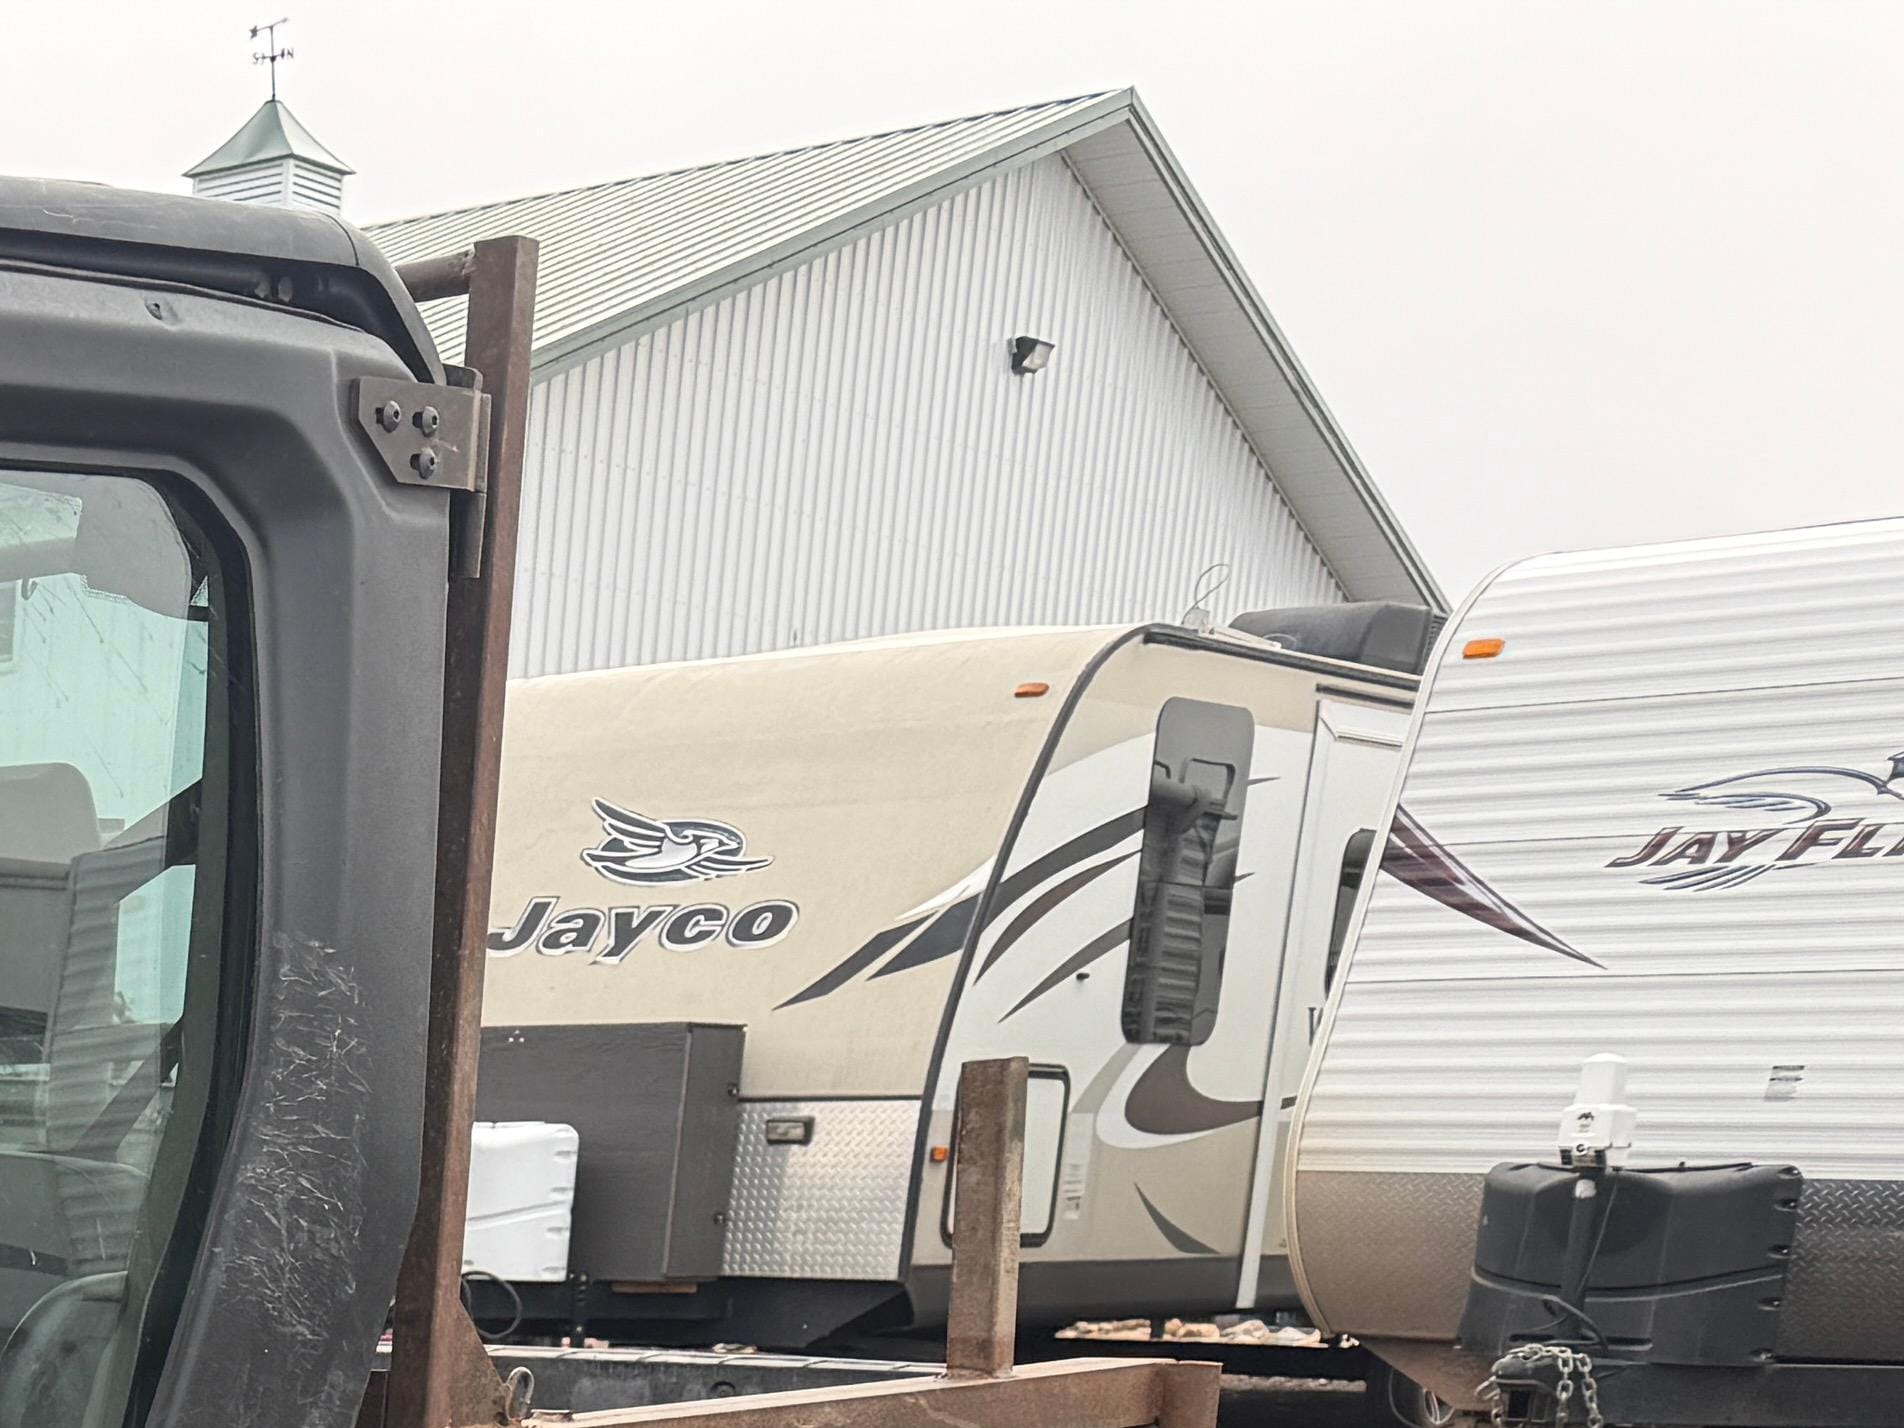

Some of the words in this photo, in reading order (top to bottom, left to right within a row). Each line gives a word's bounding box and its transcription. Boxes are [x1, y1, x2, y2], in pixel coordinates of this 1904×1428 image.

[1604, 826, 1789, 868] JAY
[1774, 816, 1904, 862] FL
[487, 895, 800, 966] Jayco
